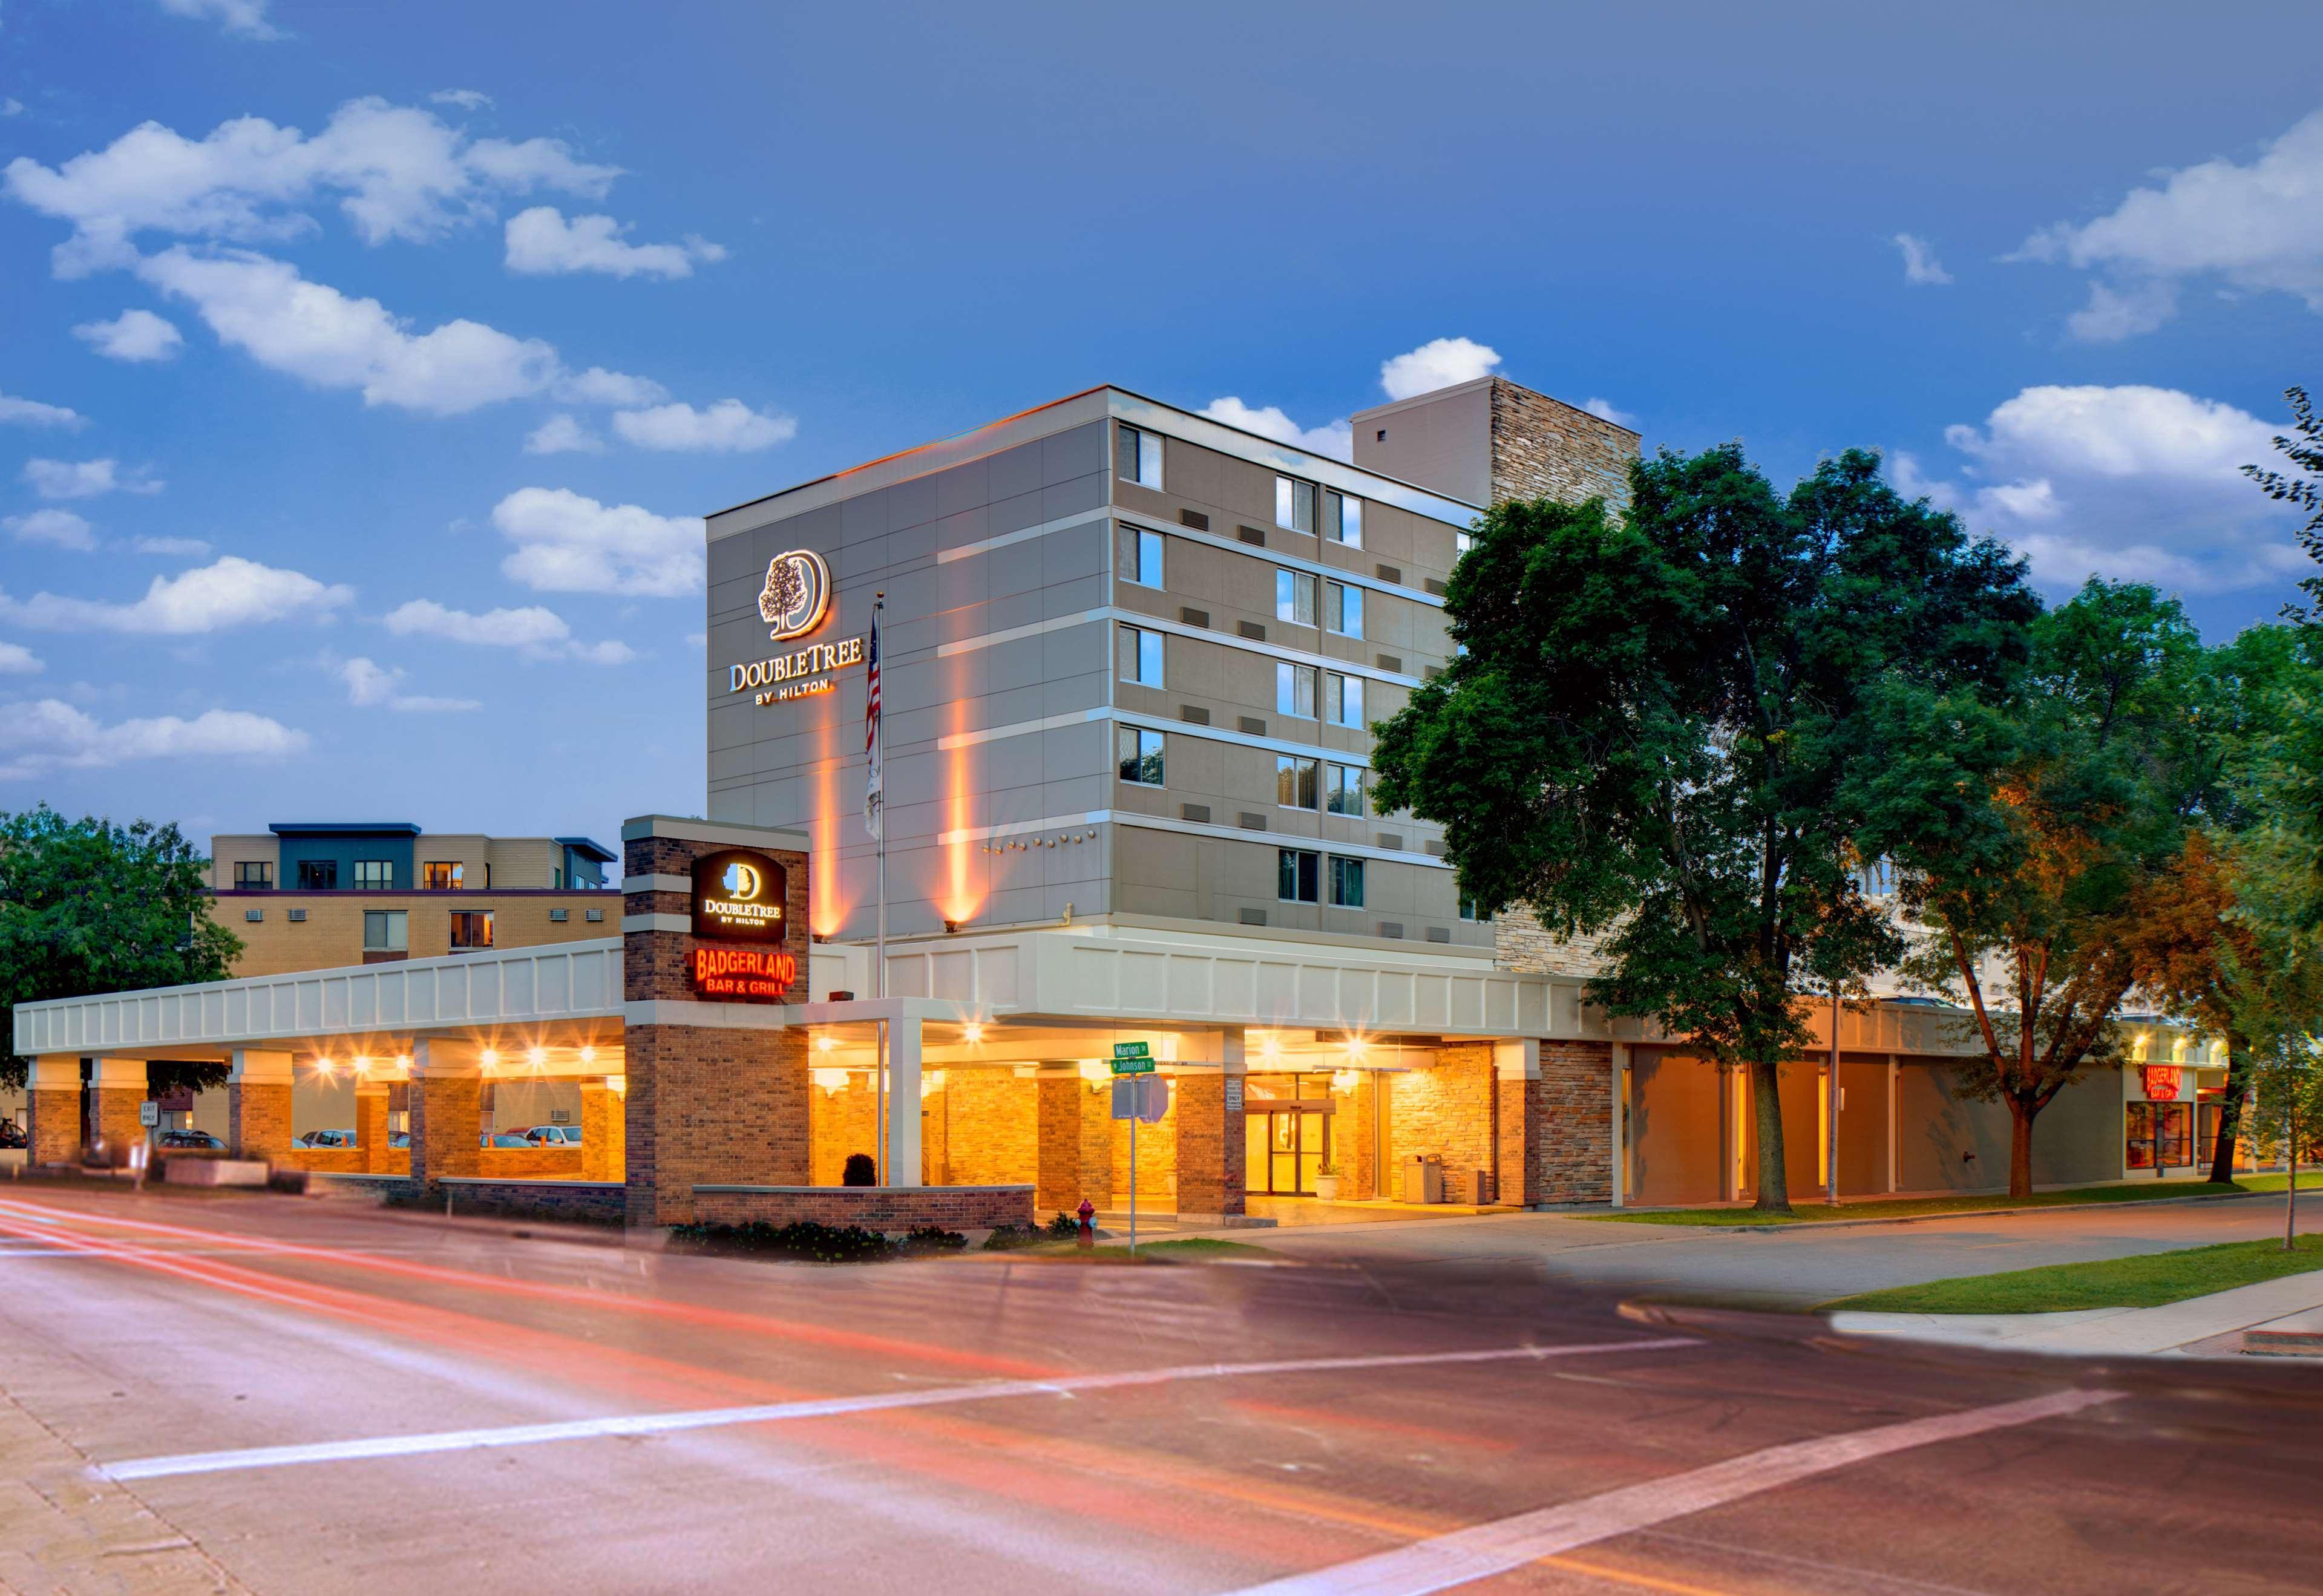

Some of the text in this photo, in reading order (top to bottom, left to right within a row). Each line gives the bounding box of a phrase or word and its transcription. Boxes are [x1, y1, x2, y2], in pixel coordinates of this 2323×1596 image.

[730, 638, 862, 692] DOUBLETREE
[755, 678, 829, 705] BY HILTON
[704, 900, 780, 918] DOUBLETREE
[696, 949, 795, 985] BADGERLAND
[706, 978, 784, 995] BAR & GRILL
[1115, 1044, 1140, 1056] Marion
[1118, 1060, 1145, 1071] Johnson
